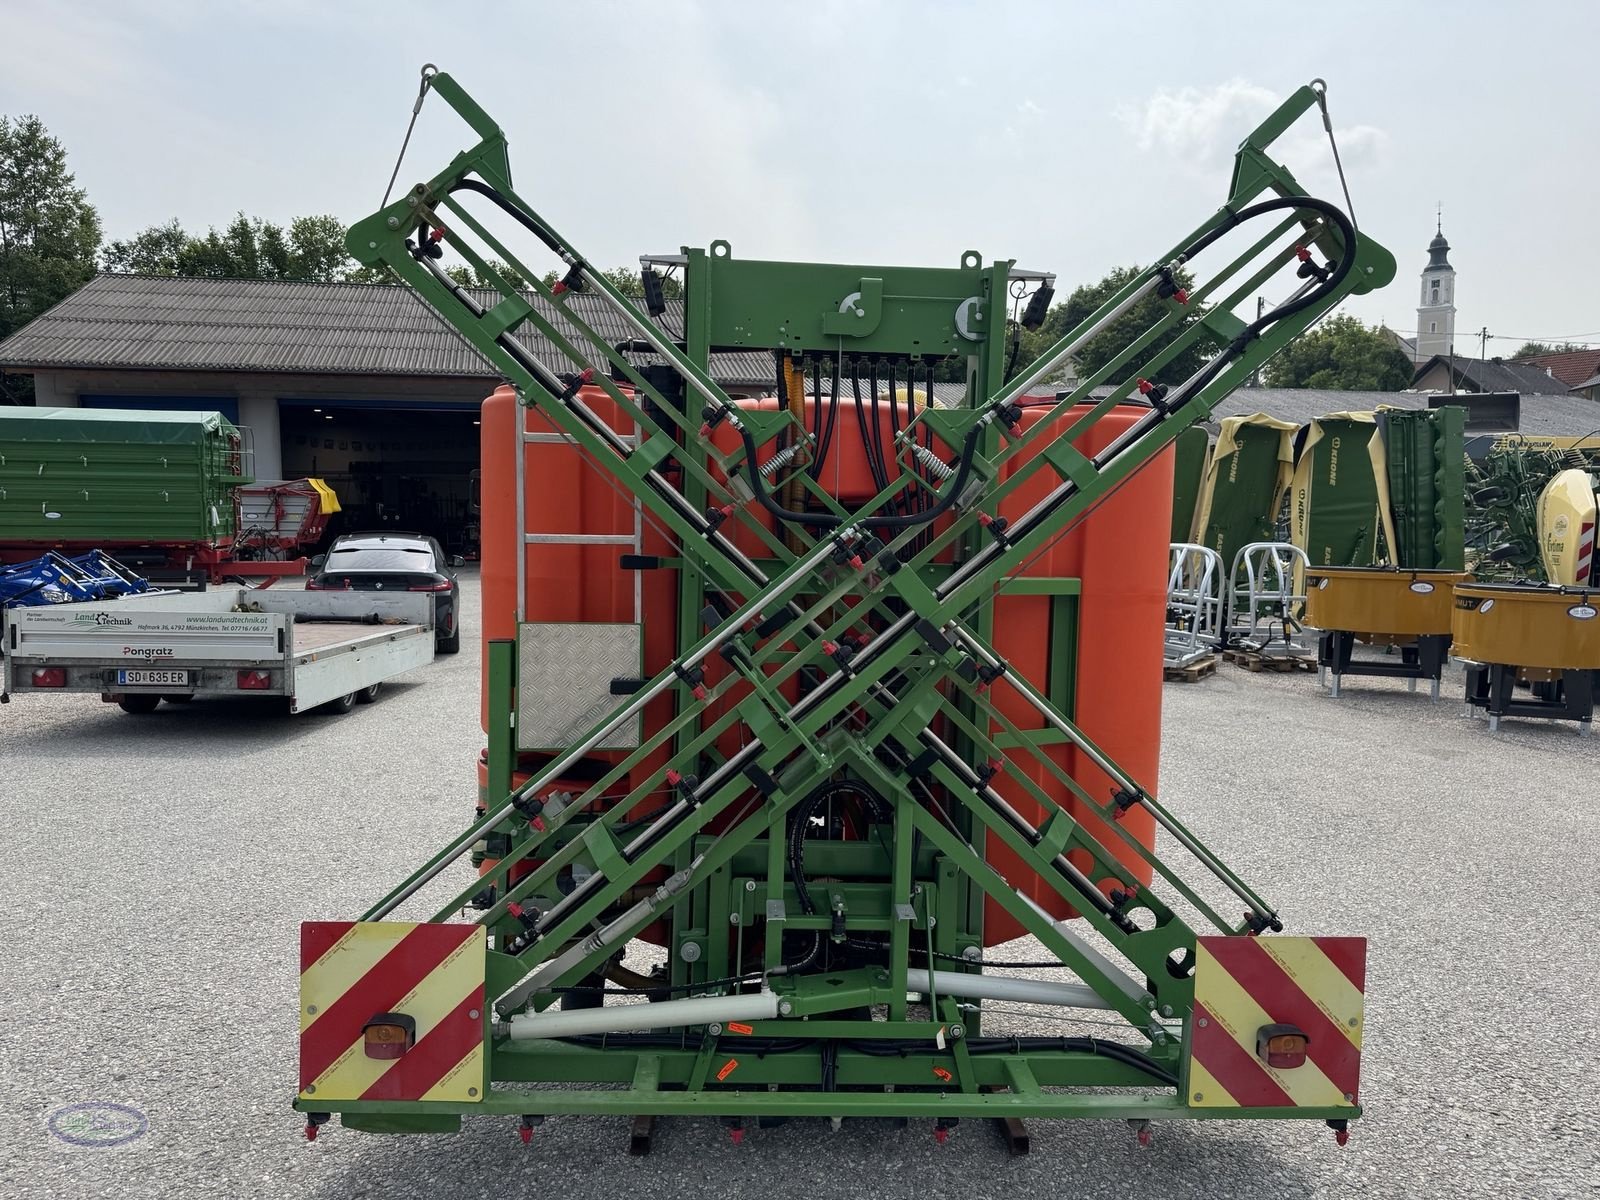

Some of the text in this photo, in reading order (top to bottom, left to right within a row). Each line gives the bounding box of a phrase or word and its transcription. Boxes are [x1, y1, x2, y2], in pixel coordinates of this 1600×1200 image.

[1329, 448, 1338, 486] KRONE
[75, 613, 132, 625] Land Technik
[123, 646, 173, 658] Pongratz
[128, 671, 184, 683] SD 635 ER
